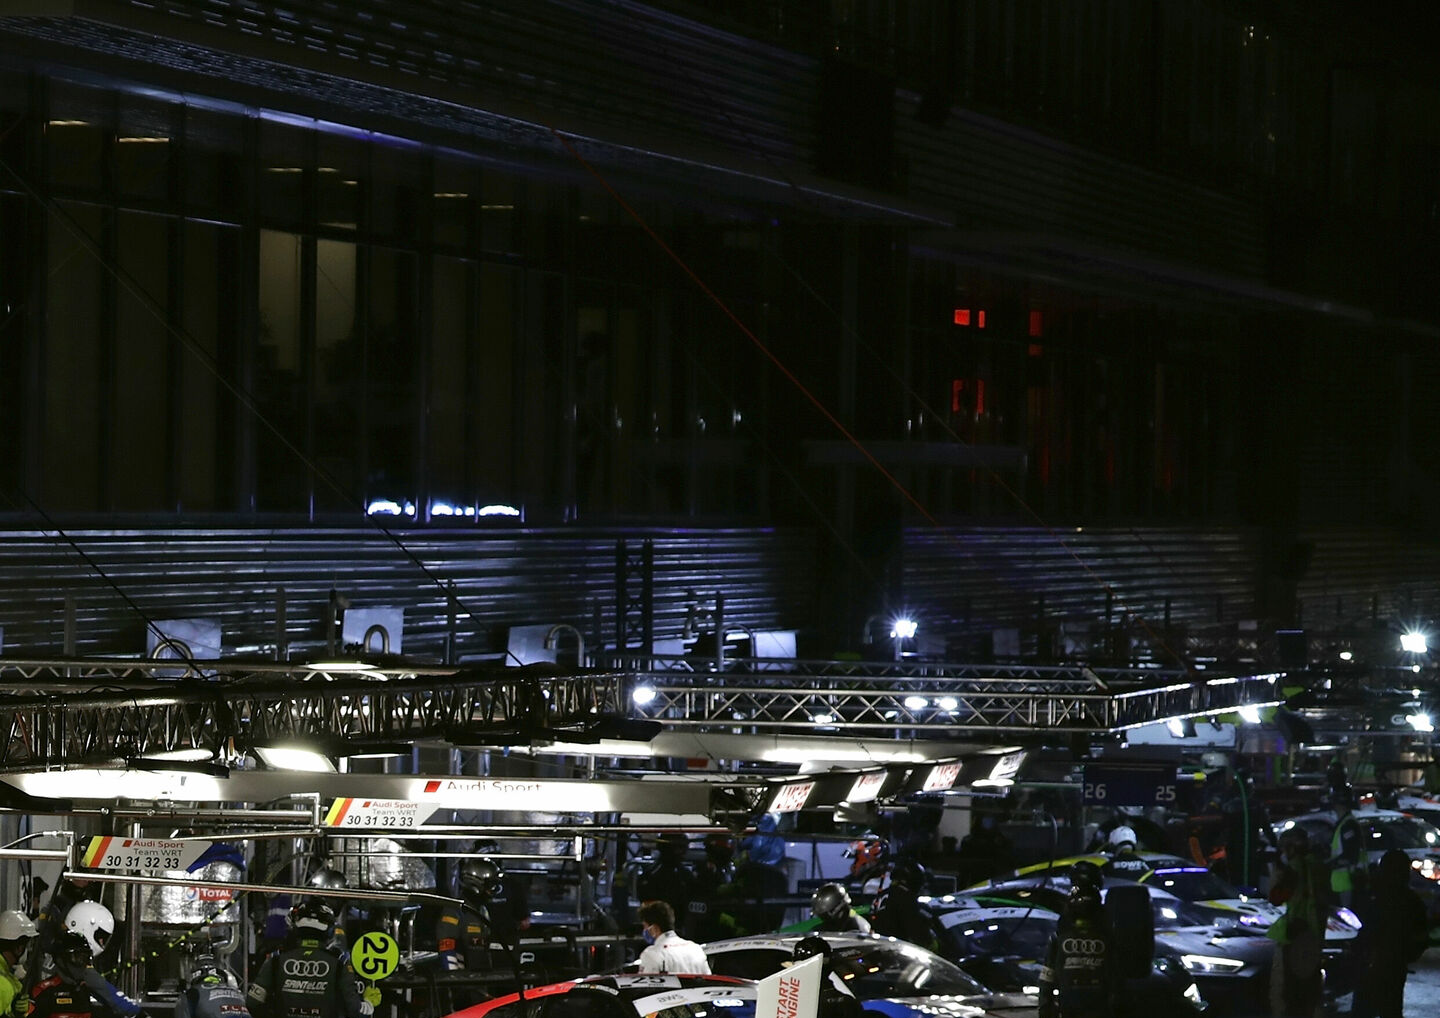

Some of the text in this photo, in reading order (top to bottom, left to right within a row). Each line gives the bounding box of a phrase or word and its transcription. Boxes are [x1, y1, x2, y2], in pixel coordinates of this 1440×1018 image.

[1084, 784, 1107, 799] 26
[1156, 786, 1177, 801] 25
[347, 815, 413, 827] 30 31 32 33
[158, 841, 185, 850] Sport
[106, 856, 179, 869] 30 31 32 33
[202, 889, 231, 898] TOTAL
[361, 936, 389, 975] 25
